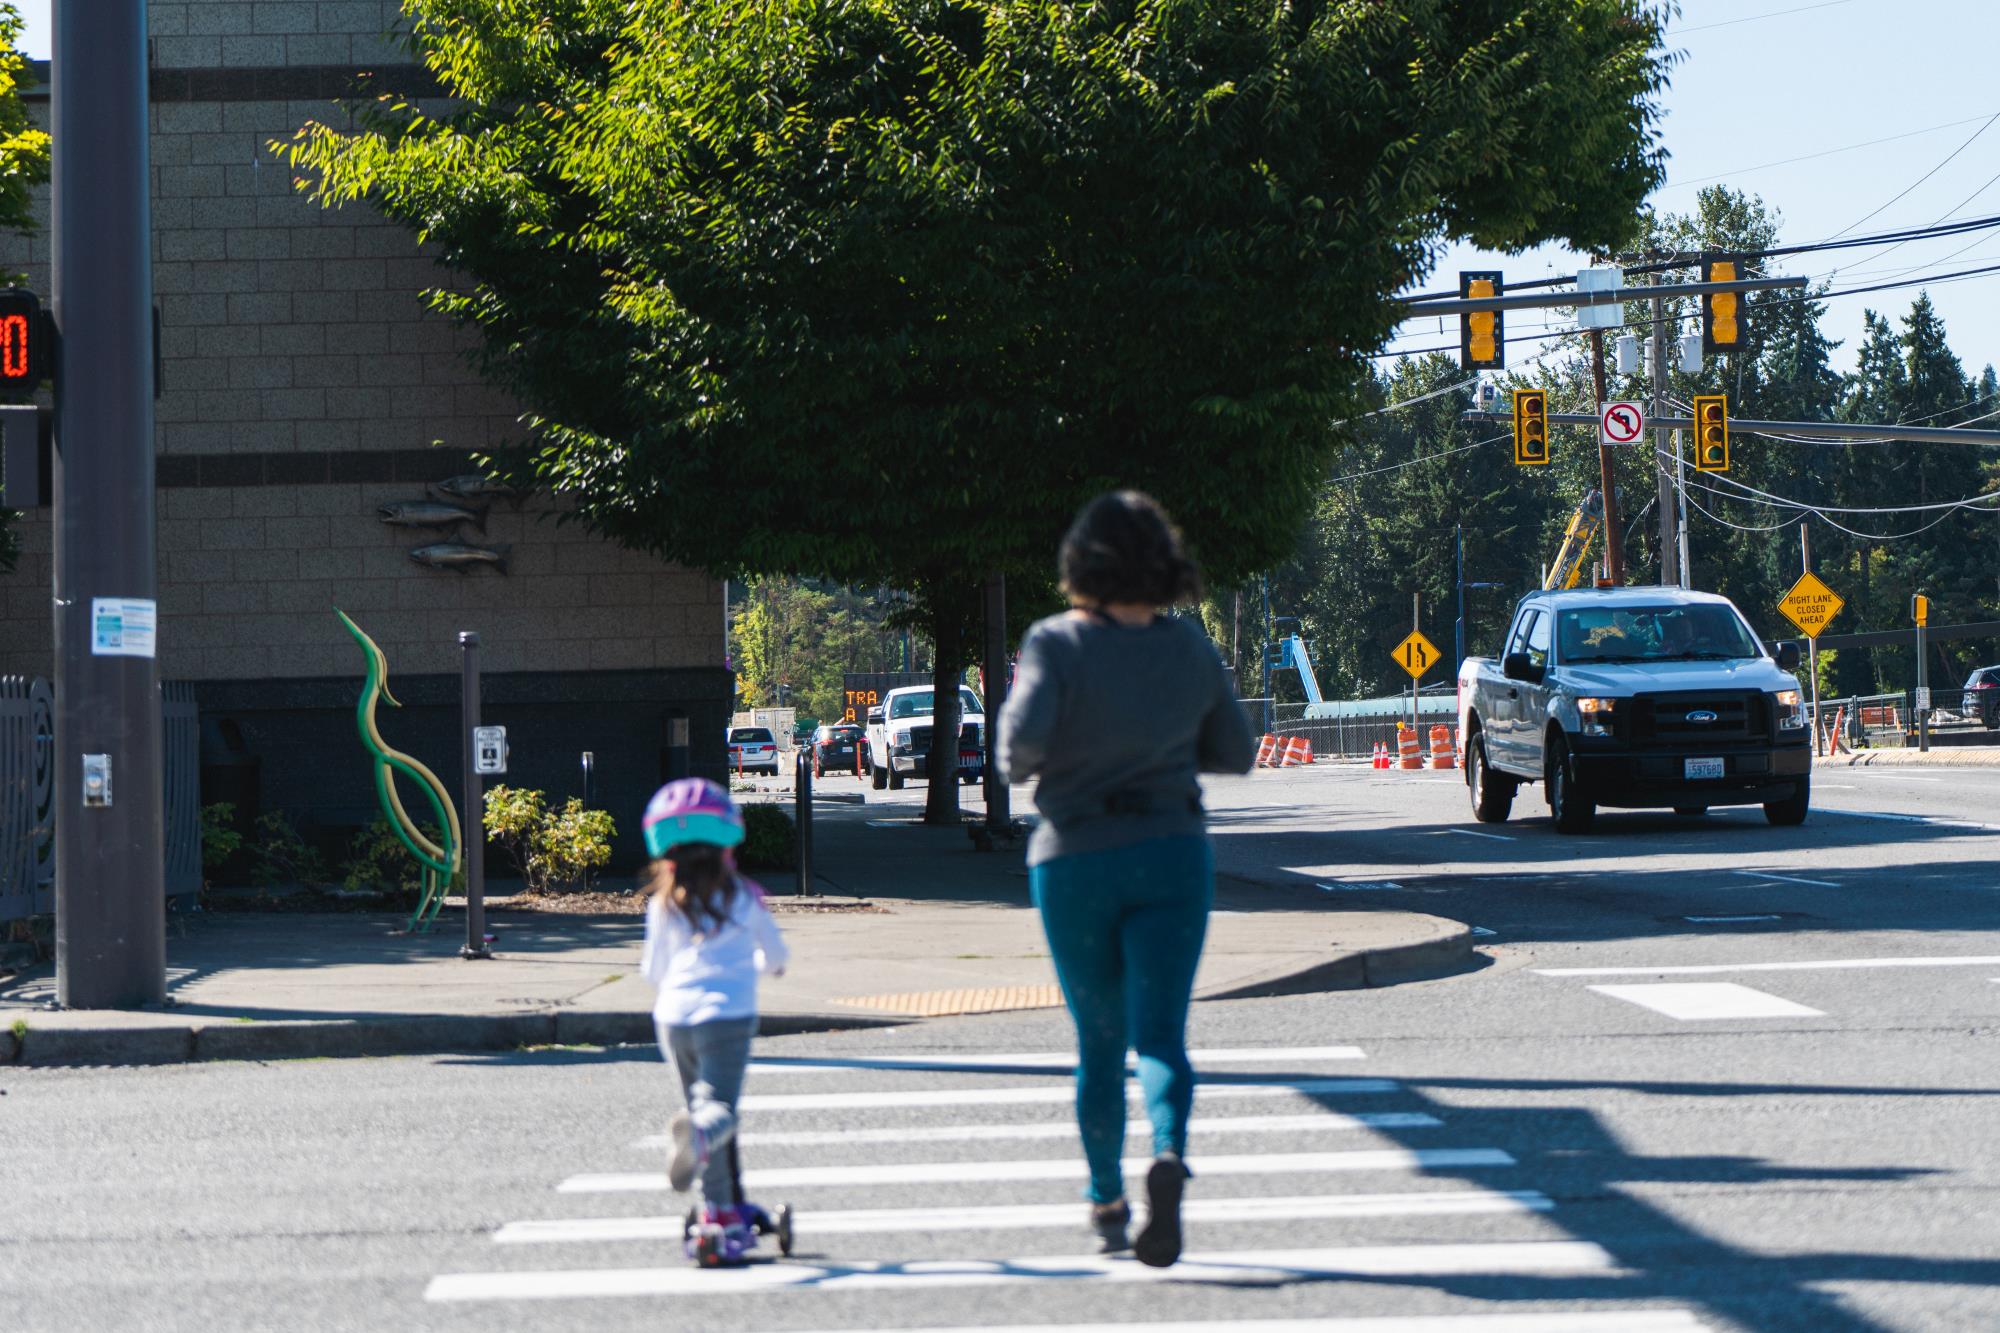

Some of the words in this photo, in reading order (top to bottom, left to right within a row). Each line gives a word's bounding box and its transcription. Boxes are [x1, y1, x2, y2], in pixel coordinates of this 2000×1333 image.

[0, 315, 27, 377] 0
[1788, 596, 1811, 605] RIGHT
[1813, 595, 1832, 603] LANE
[1796, 605, 1826, 614] CLOSED
[1800, 615, 1825, 624] AHEAD
